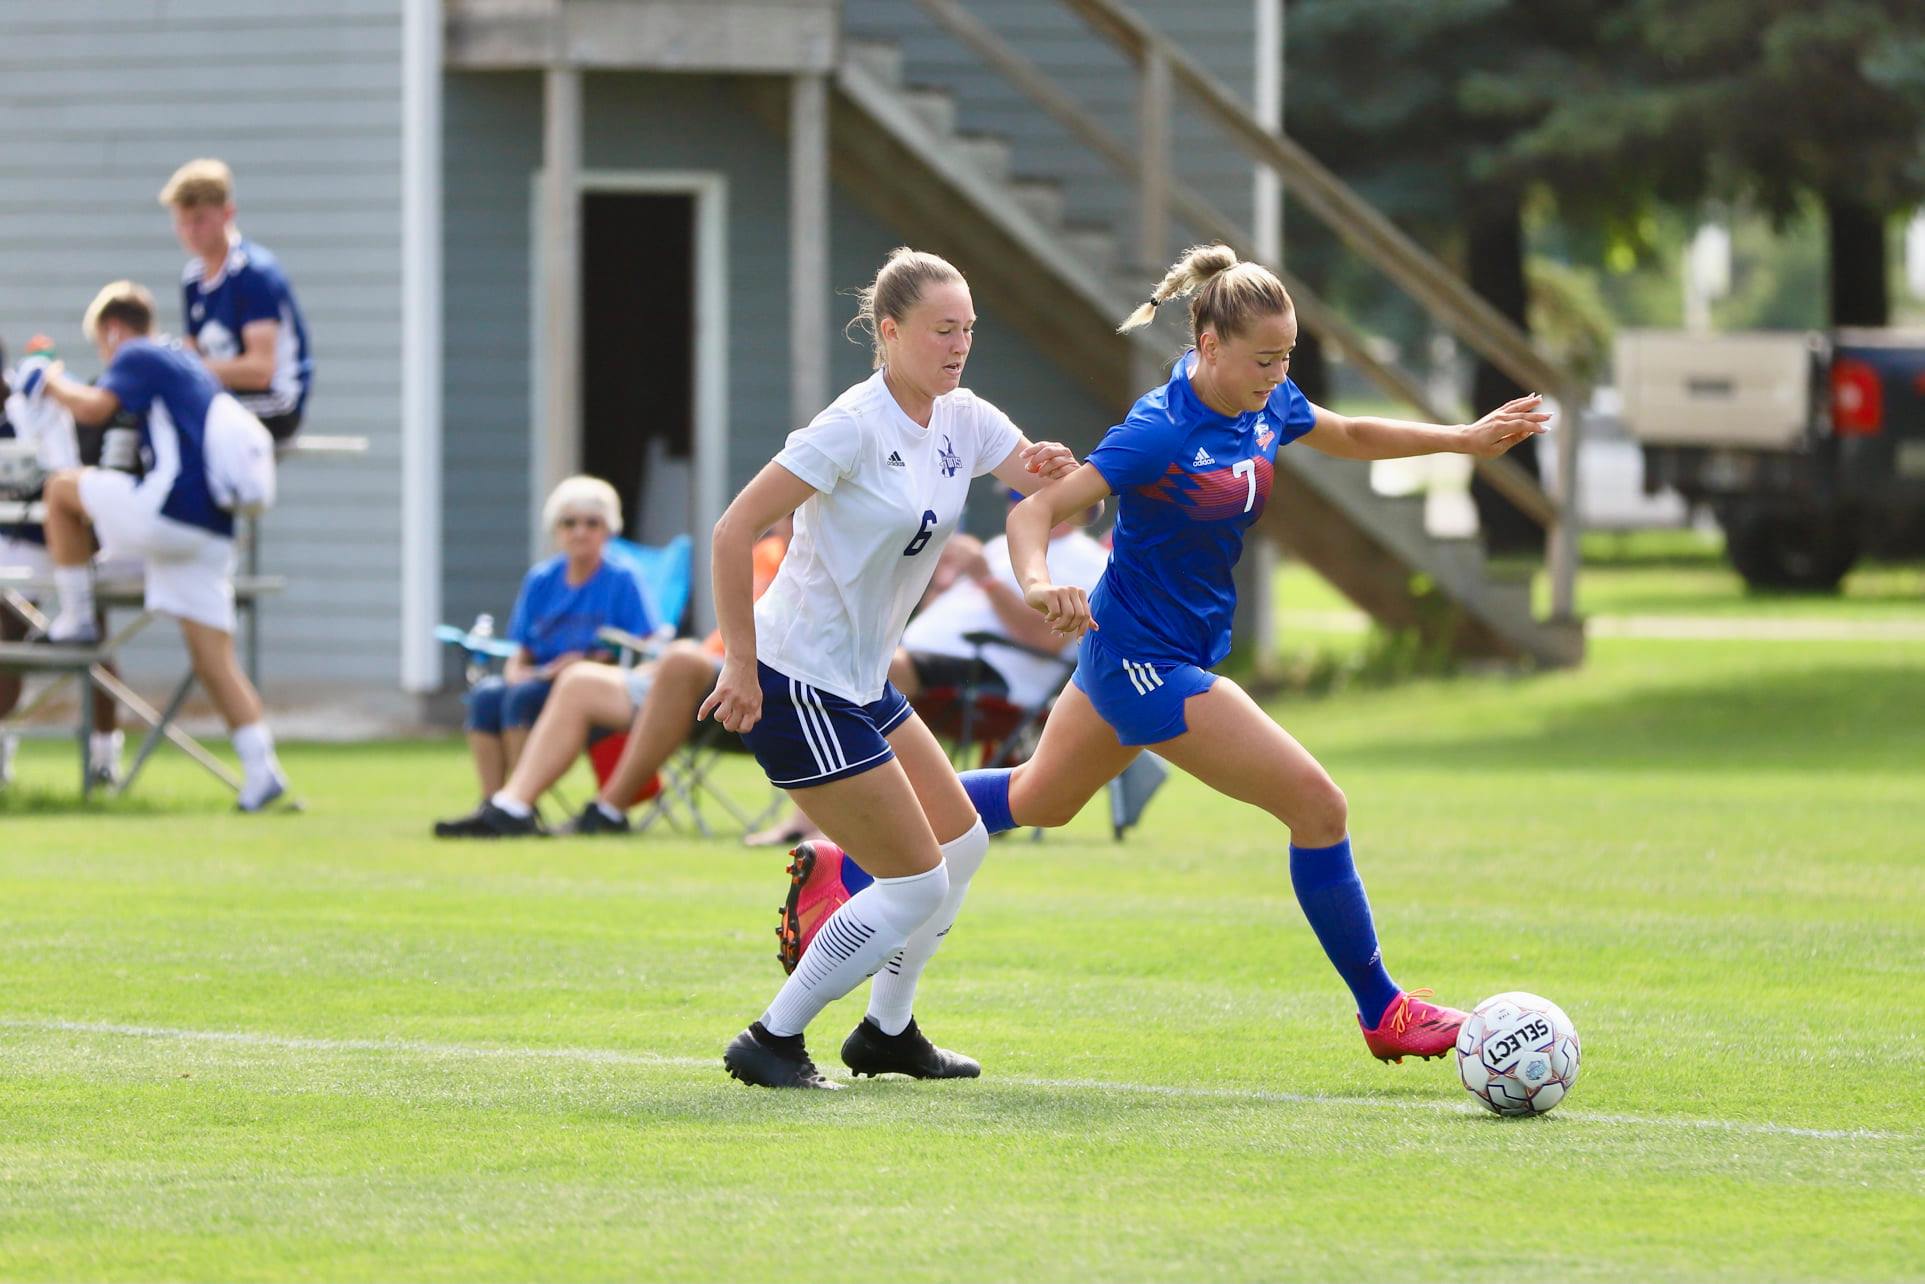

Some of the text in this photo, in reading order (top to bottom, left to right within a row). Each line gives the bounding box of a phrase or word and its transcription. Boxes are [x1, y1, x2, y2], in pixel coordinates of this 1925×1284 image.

[1193, 458, 1215, 467] adidas
[1232, 459, 1256, 513] 7
[903, 509, 937, 556] 6
[1487, 1019, 1549, 1065] SELECT
